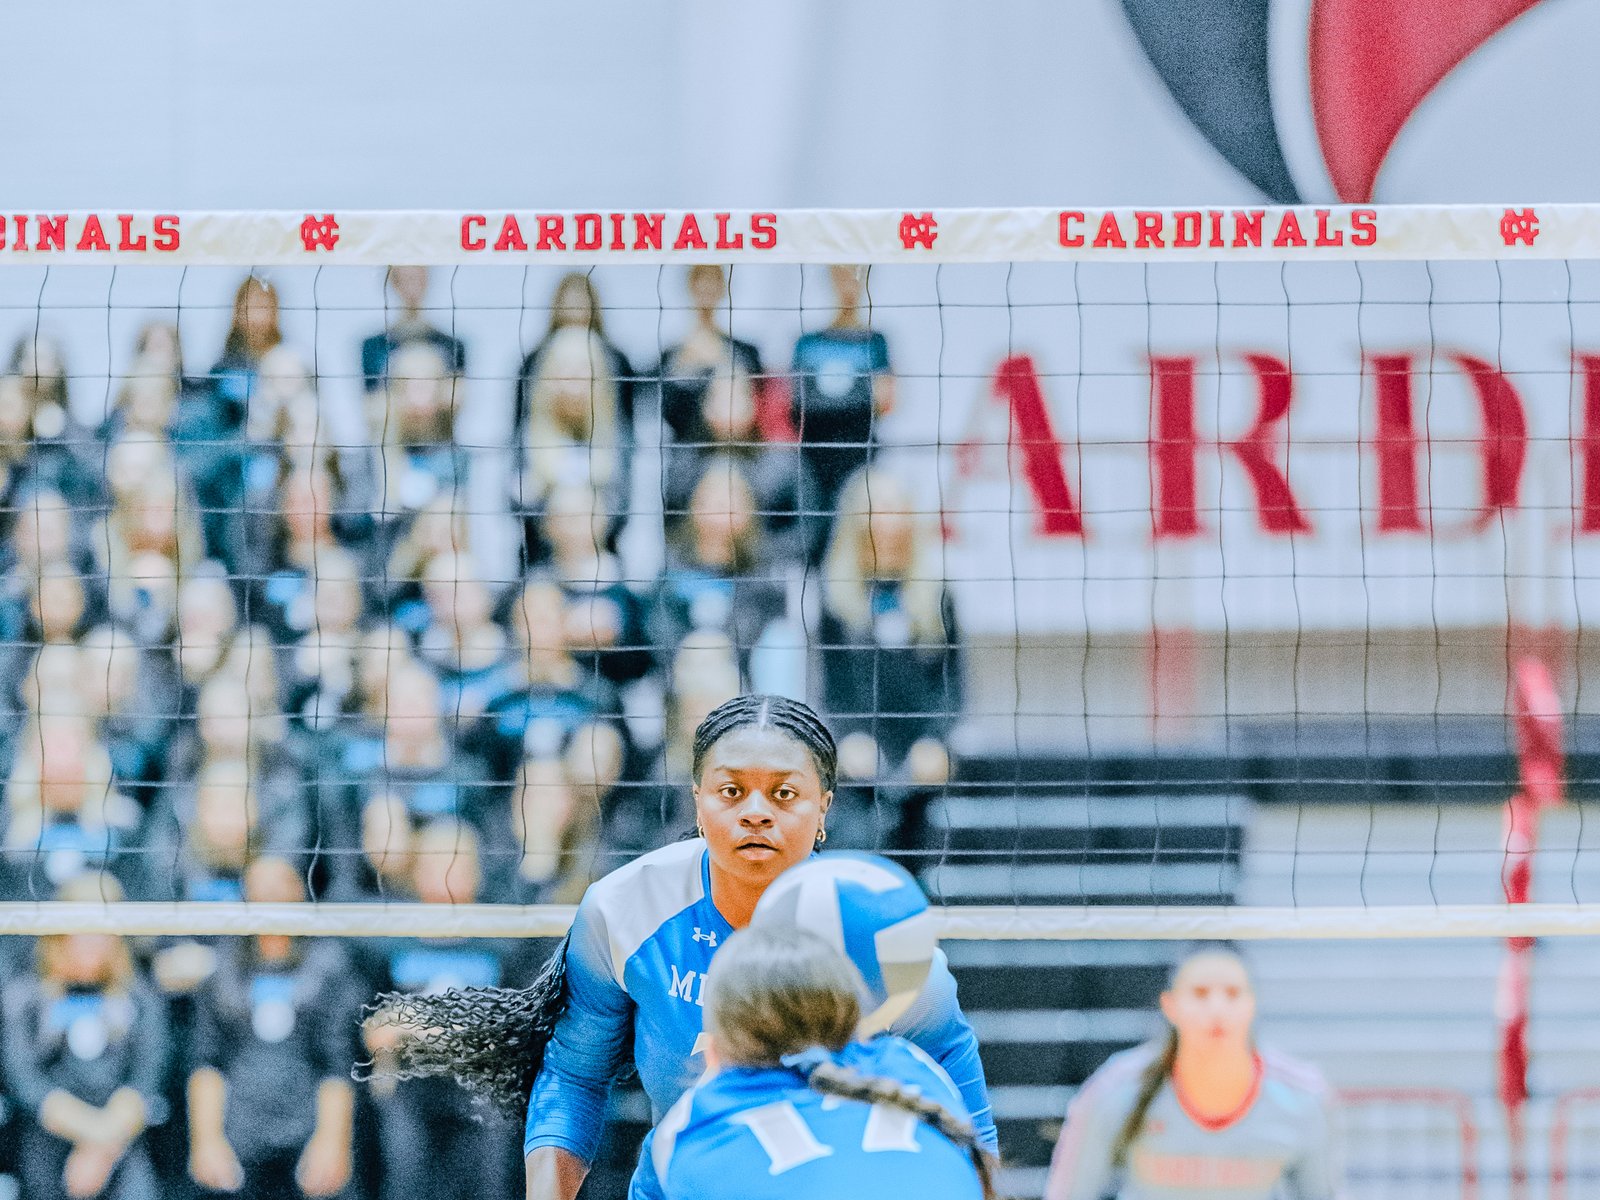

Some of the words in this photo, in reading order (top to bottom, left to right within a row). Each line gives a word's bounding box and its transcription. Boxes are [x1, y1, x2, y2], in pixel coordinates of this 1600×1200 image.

[0, 214, 180, 252] INALS
[460, 213, 777, 251] CARDINALS
[1058, 210, 1377, 249] CARDINALS
